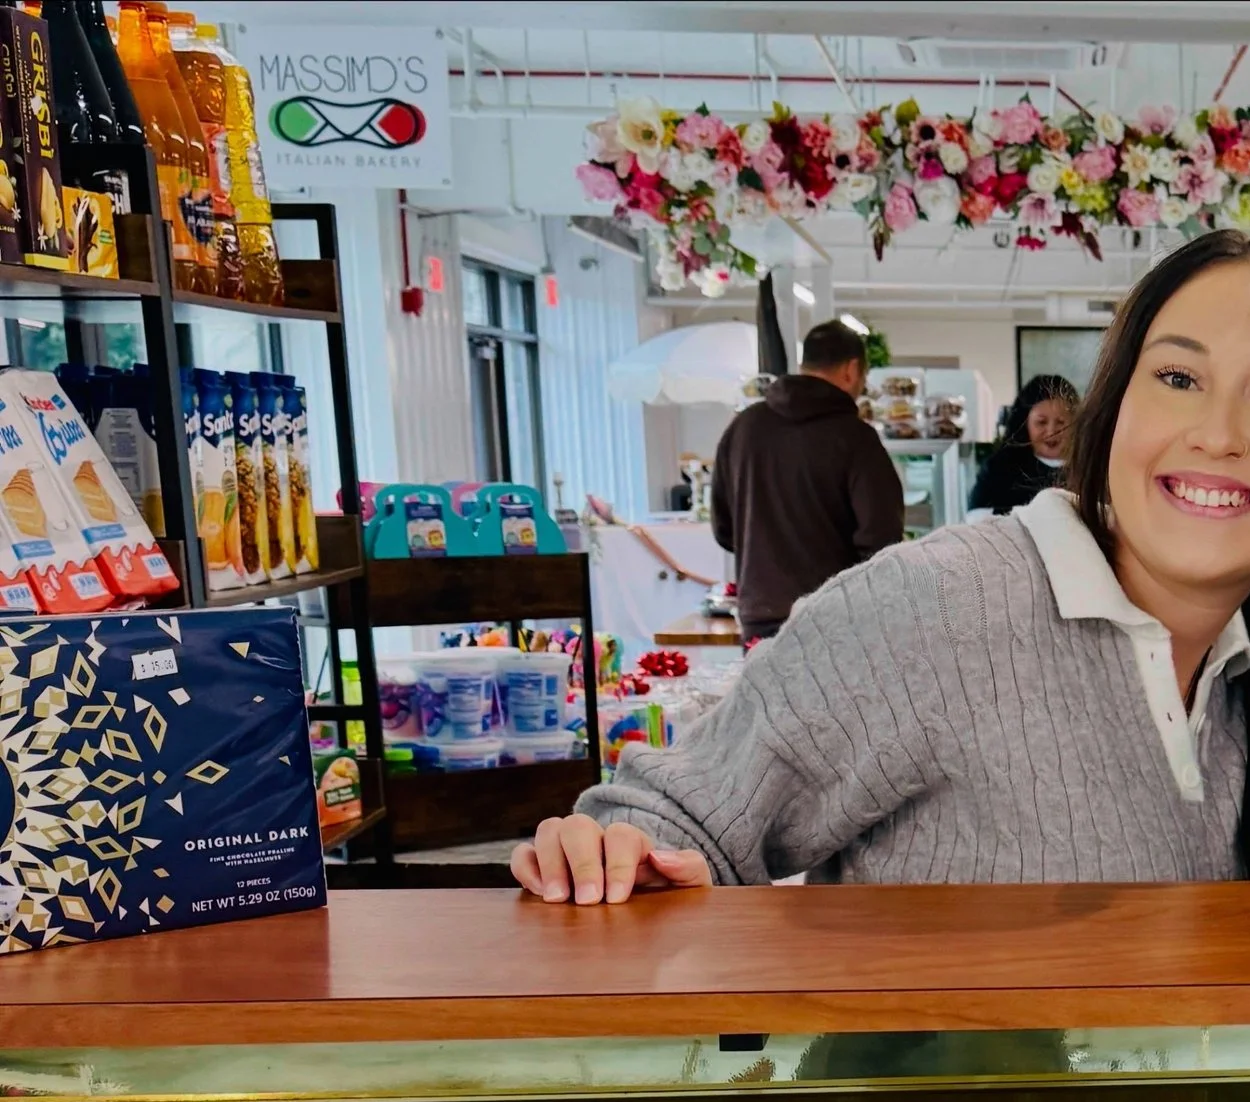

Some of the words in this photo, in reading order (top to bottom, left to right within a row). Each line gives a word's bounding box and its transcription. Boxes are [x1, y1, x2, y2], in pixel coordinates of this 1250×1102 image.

[259, 54, 428, 93] MASSIMO'S
[276, 152, 346, 167] ITALIAN
[354, 153, 422, 169] BAKERY
[184, 832, 263, 852] ORIGINAL
[268, 825, 309, 843] DARK
[236, 880, 245, 888] 12
[246, 876, 272, 887] PIECES
[191, 899, 214, 913] NET
[216, 896, 235, 908] WT
[238, 893, 263, 906] 5.29
[265, 891, 281, 901] OZ
[283, 885, 317, 900] (150g)
